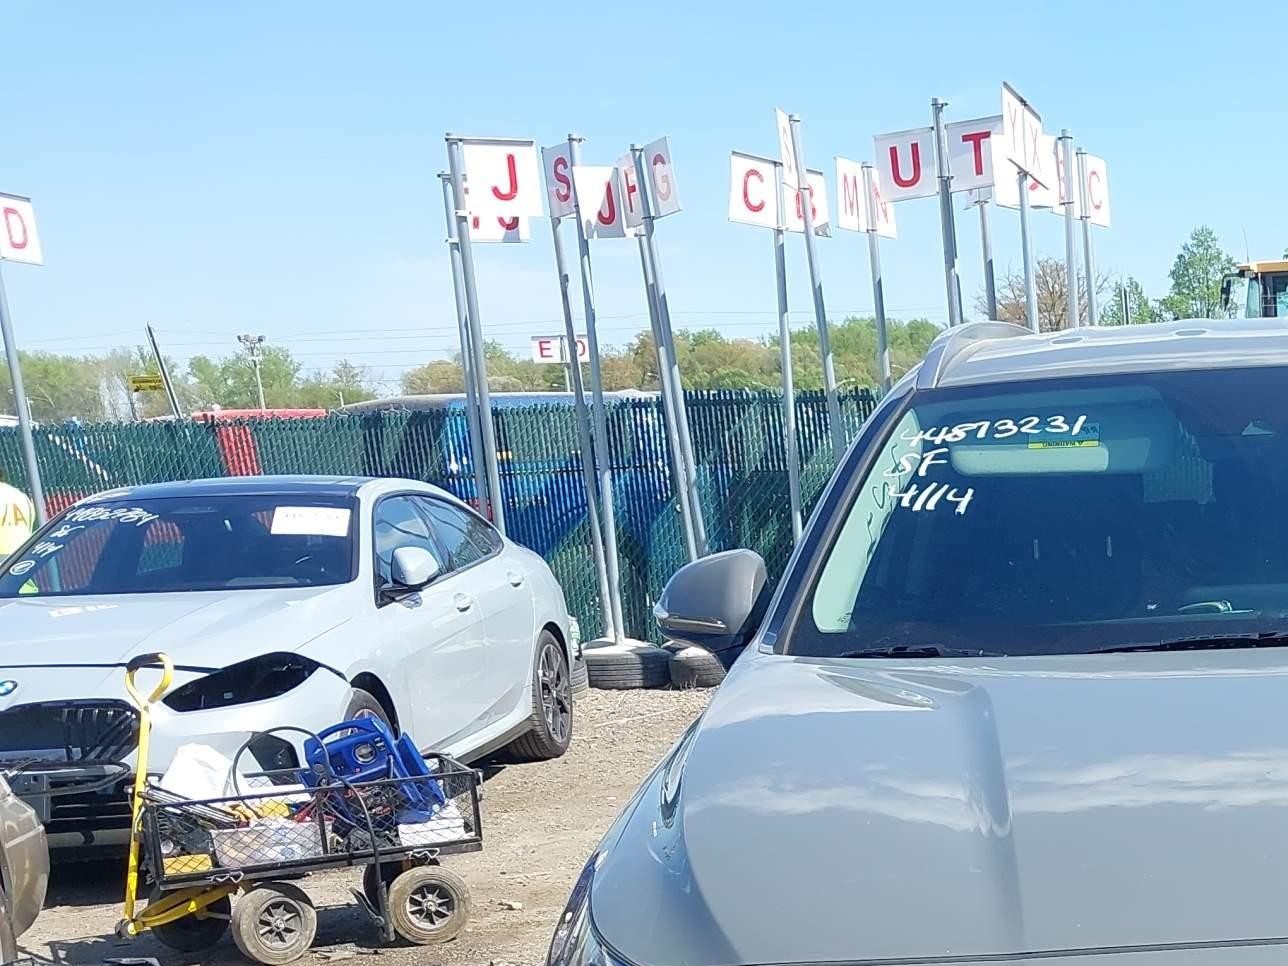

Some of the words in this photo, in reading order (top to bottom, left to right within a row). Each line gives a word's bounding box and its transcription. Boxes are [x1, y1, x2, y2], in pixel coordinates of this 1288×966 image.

[491, 153, 518, 201] J
[553, 157, 571, 202] S
[889, 142, 921, 188] U
[961, 131, 991, 177] T
[743, 168, 766, 213] C
[843, 173, 859, 217] M
[1088, 170, 1103, 210] C
[3, 206, 29, 250] D
[538, 340, 554, 358] E
[883, 447, 949, 477] SF
